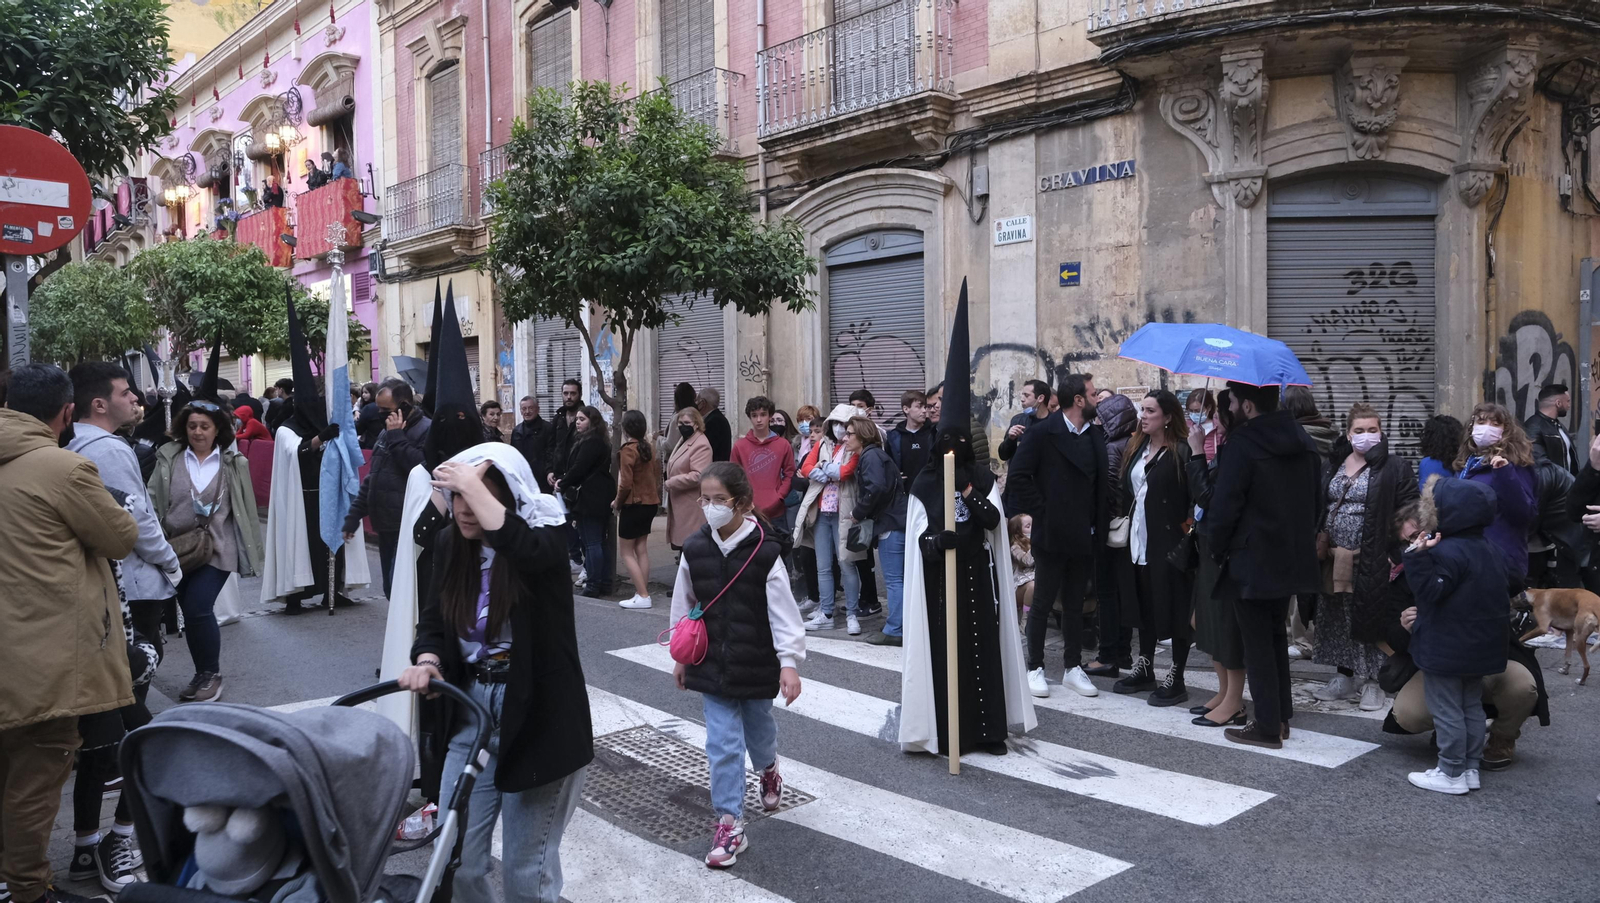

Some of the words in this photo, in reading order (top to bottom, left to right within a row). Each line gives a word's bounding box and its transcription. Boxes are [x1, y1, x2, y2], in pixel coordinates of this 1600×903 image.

[1040, 161, 1134, 192] GRAVINA
[1006, 217, 1028, 227] CALLE
[998, 229, 1027, 242] GRAVINA
[1195, 355, 1218, 364] BUENA
[1218, 359, 1238, 367] CARA
